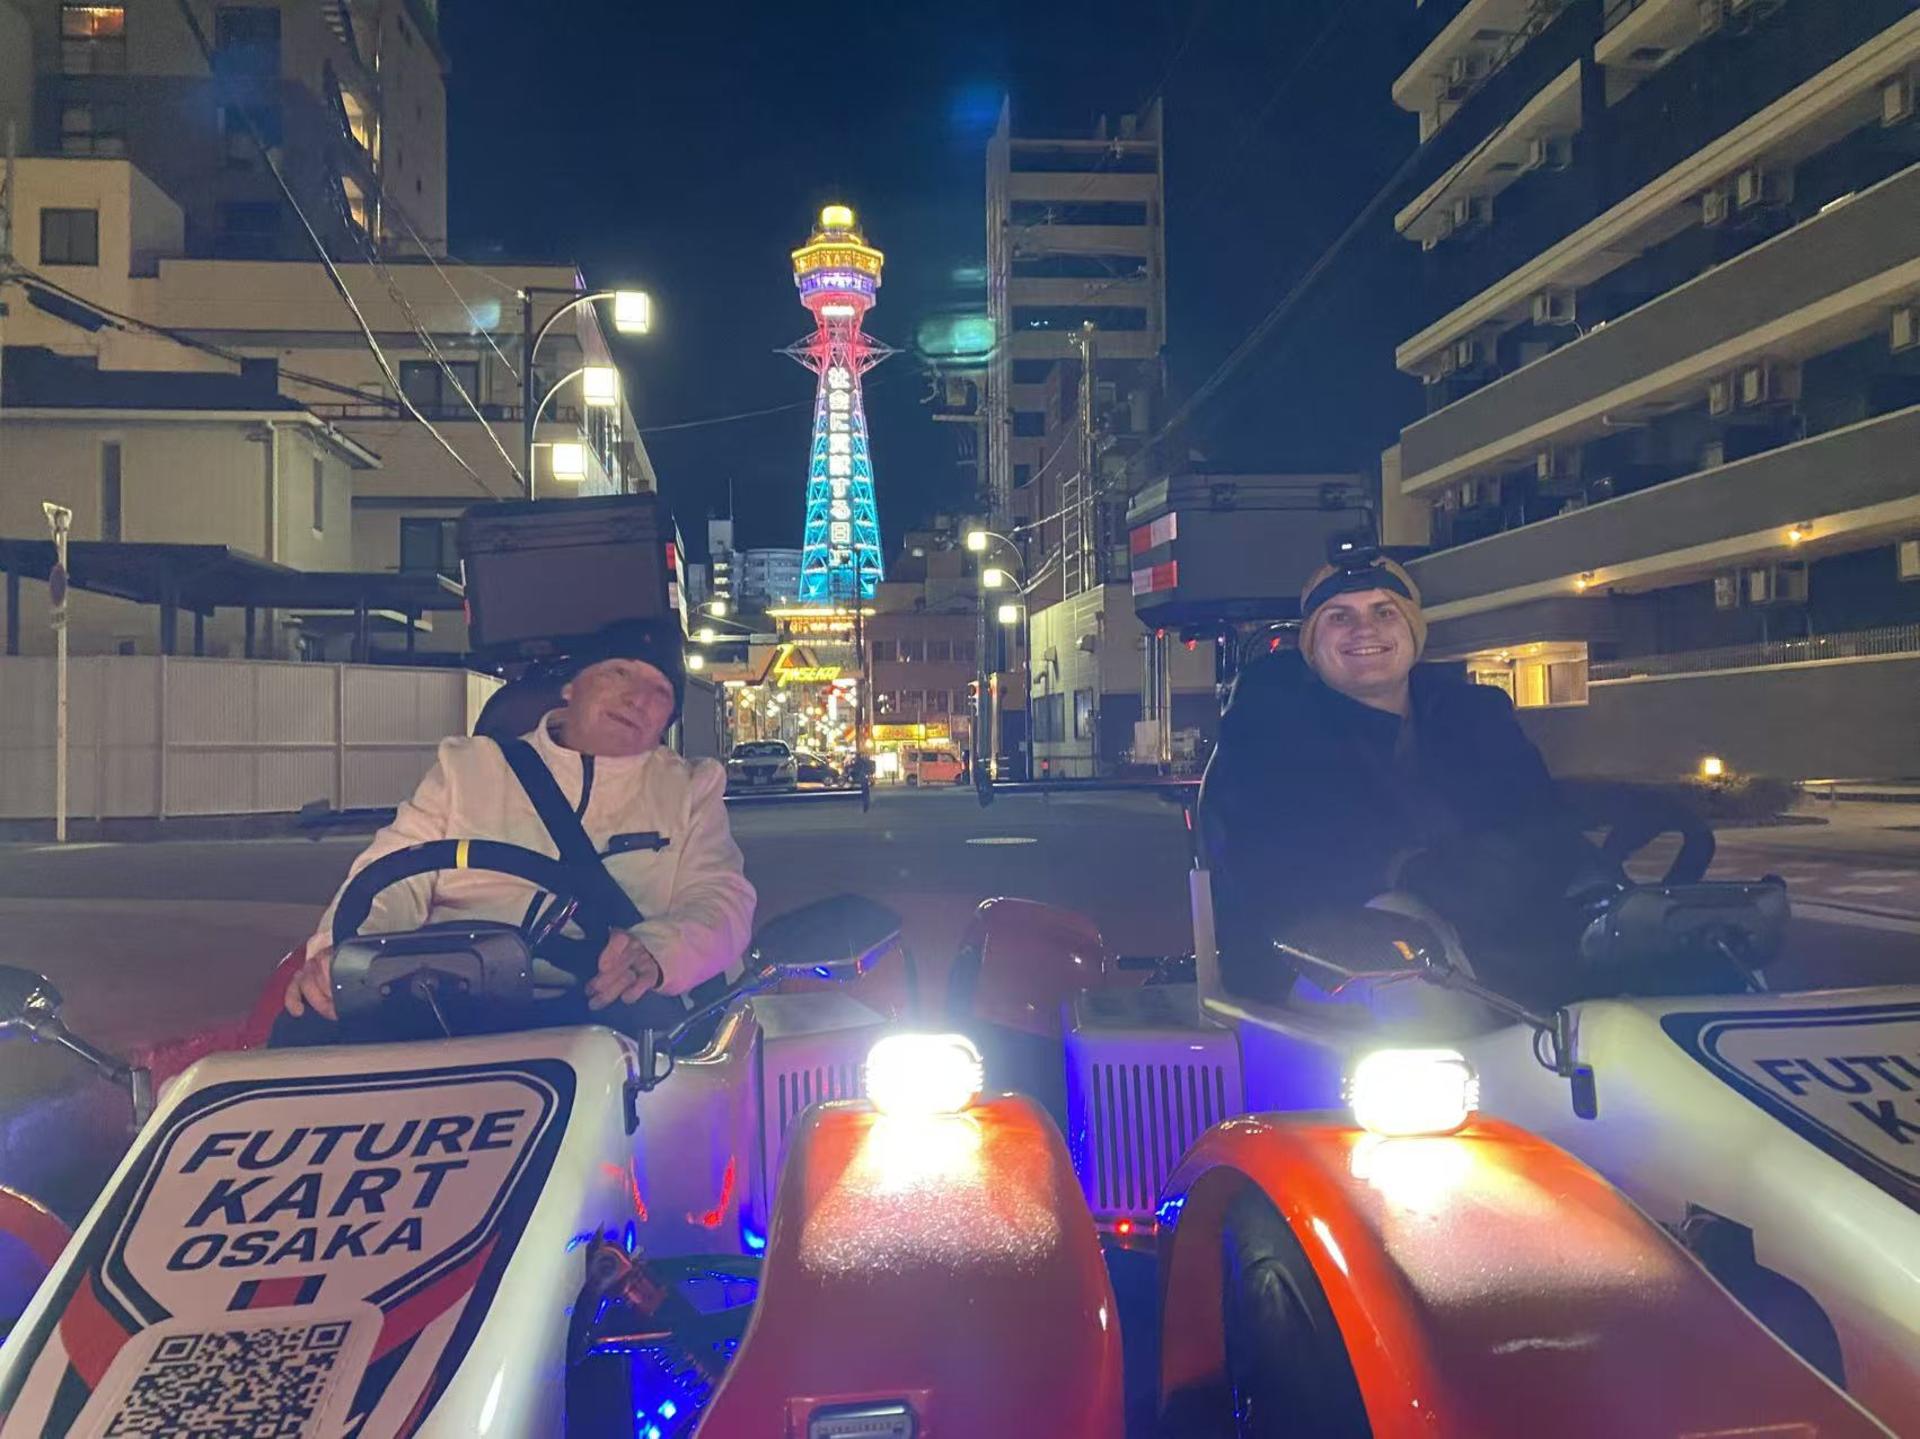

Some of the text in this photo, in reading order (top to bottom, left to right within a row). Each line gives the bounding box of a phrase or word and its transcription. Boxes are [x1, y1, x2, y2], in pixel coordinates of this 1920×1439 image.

[178, 1109, 526, 1174] FUTURE
[184, 1159, 469, 1228] KART
[166, 1216, 422, 1272] OSAKA
